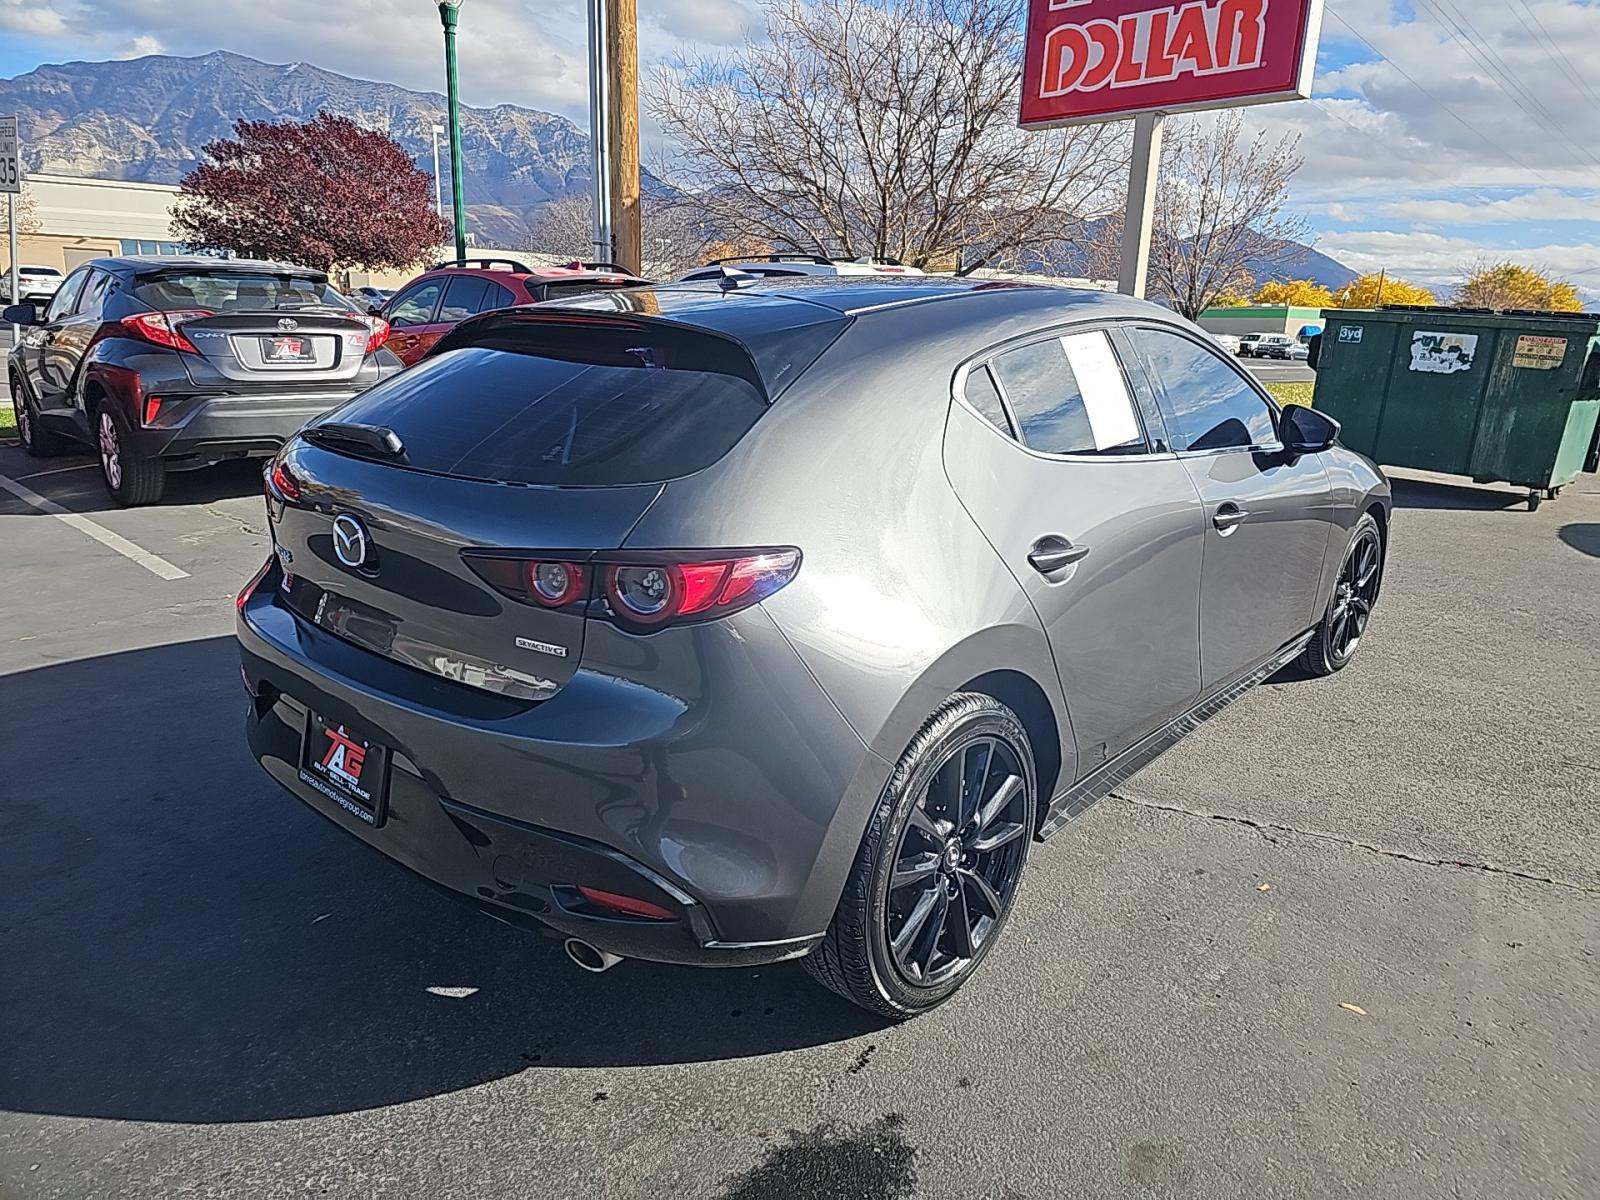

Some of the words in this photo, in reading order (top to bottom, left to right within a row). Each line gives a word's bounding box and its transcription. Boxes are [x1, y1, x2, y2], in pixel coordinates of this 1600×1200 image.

[1039, 0, 1266, 98] DOLLAR
[0, 157, 17, 185] 35
[1340, 327, 1361, 341] 3yd
[321, 727, 367, 786] TAG
[313, 761, 328, 774] BUY
[329, 772, 345, 785] SELL
[348, 781, 371, 801] TRADE
